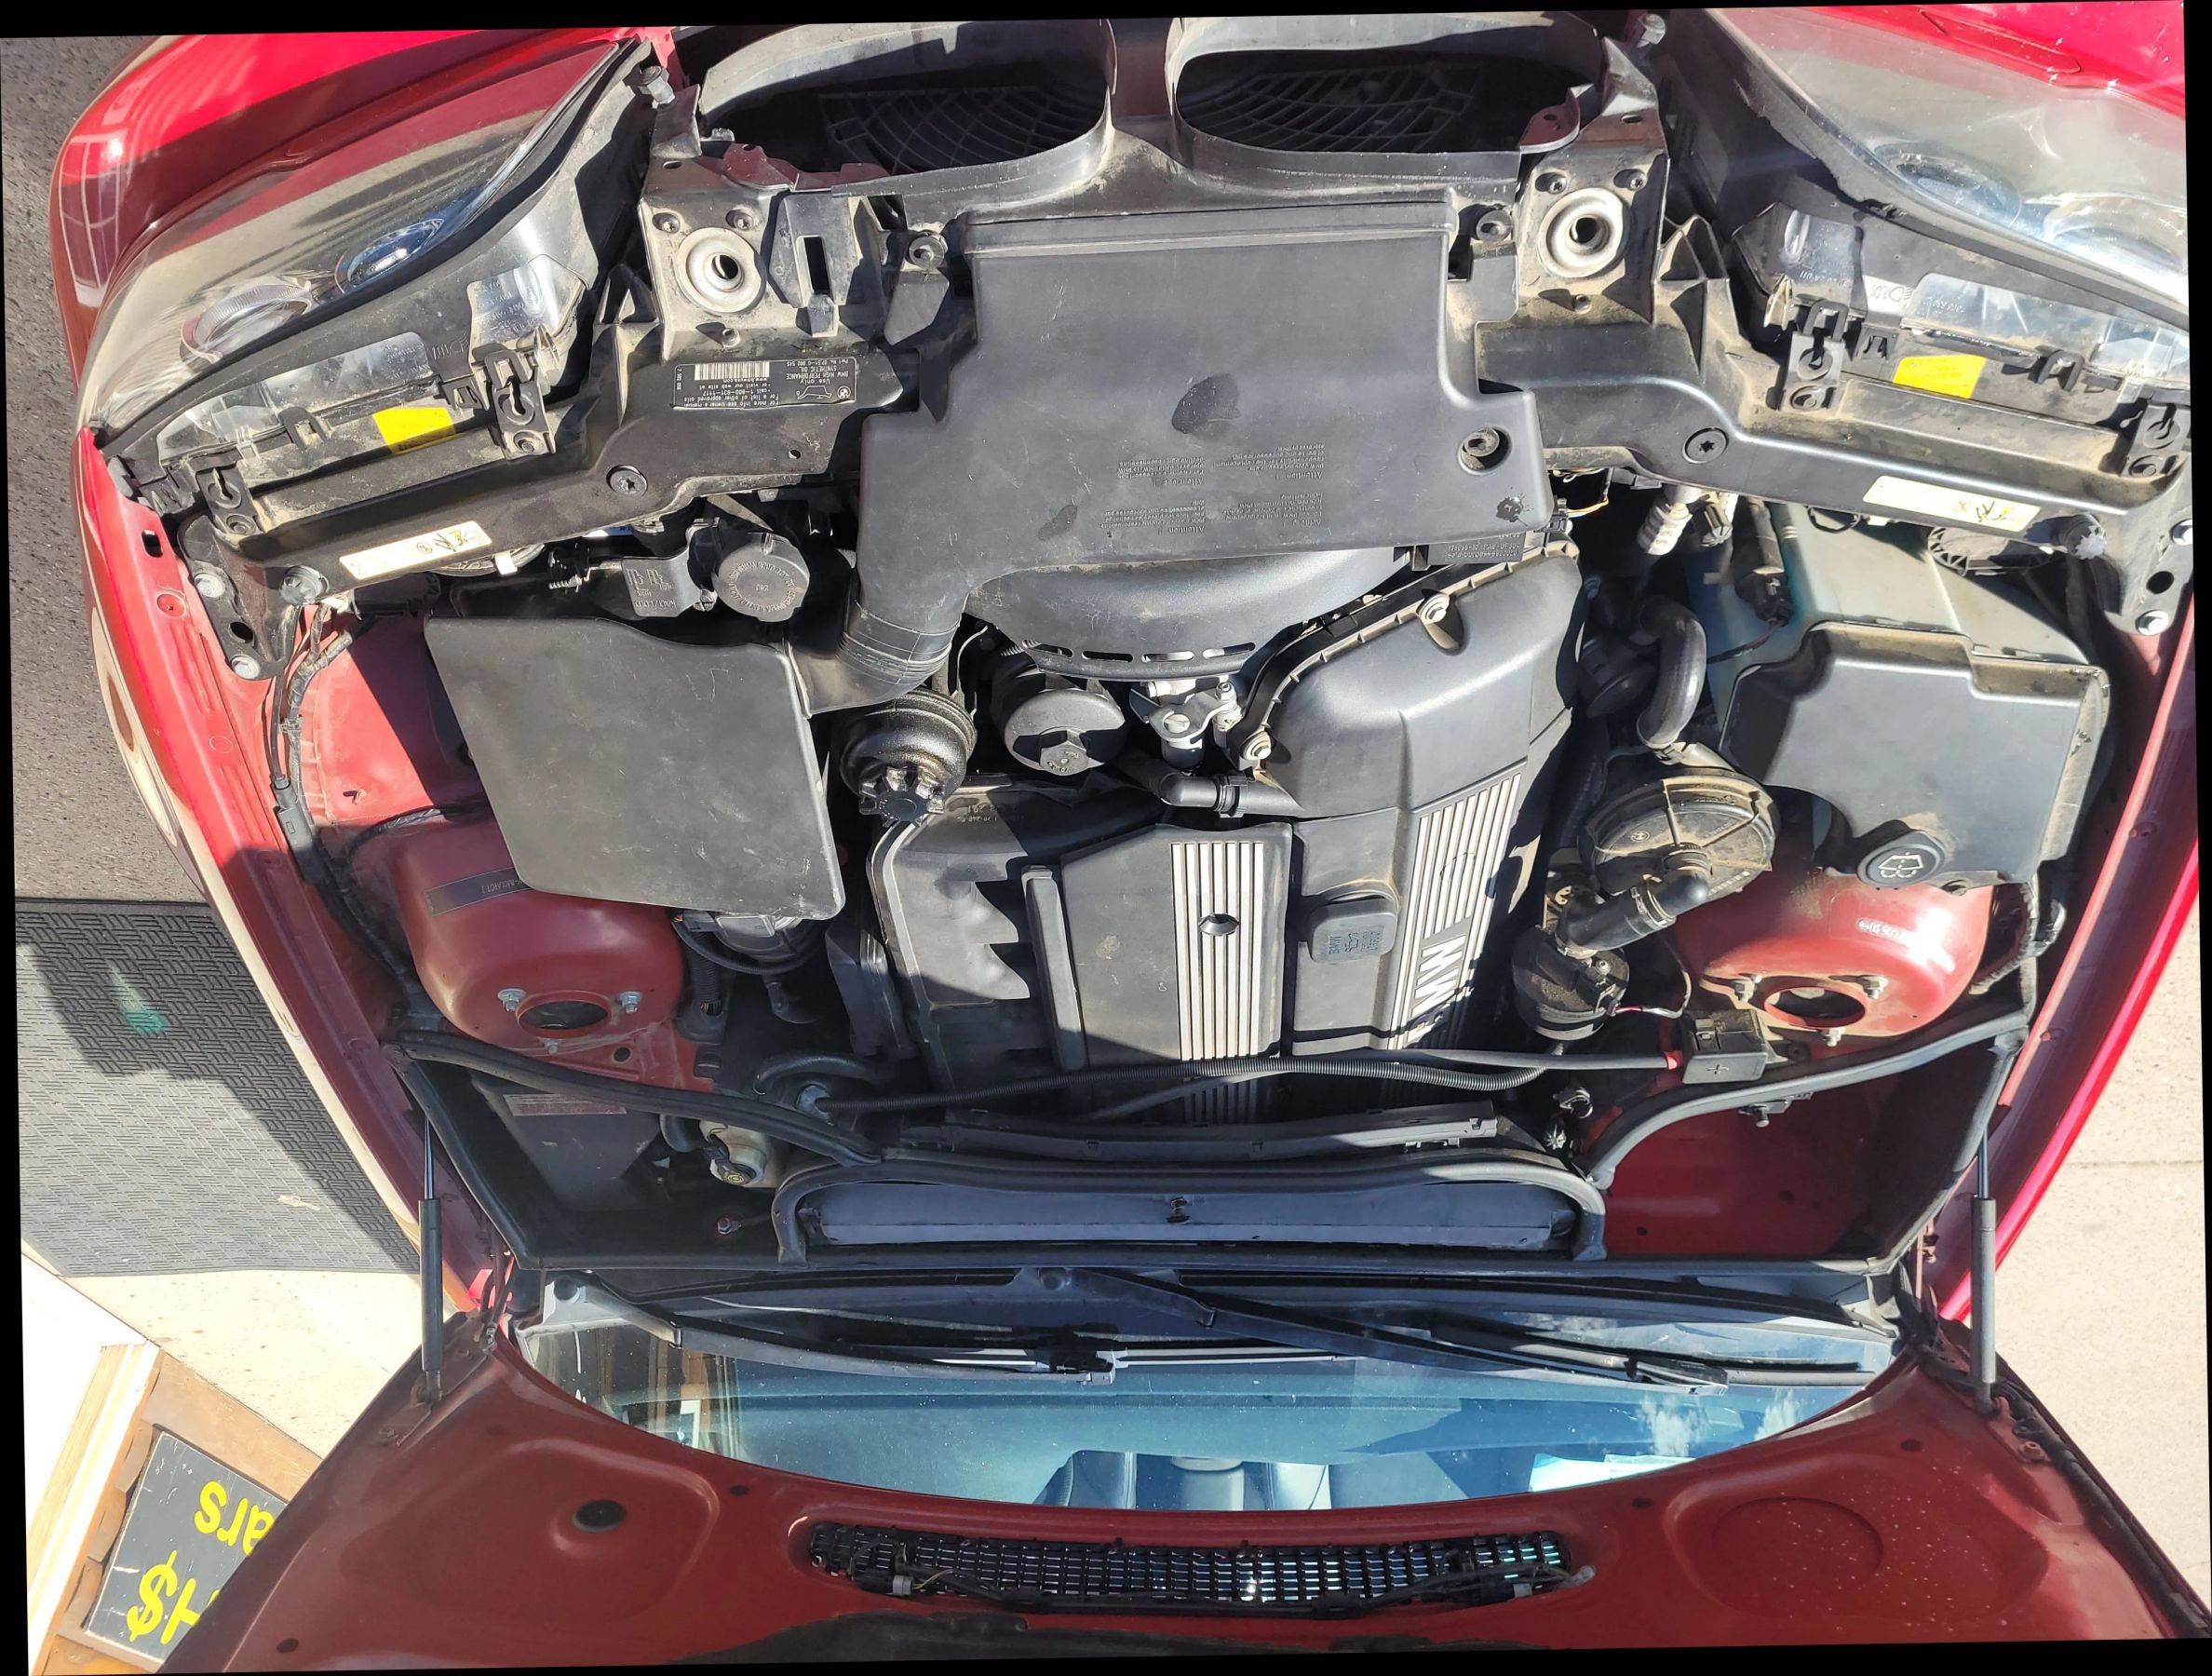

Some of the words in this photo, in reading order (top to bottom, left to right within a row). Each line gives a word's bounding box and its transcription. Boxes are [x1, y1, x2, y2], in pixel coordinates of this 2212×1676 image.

[800, 377, 815, 385] only
[1167, 525, 1204, 534] Attention
[1329, 936, 1342, 954] BMW
